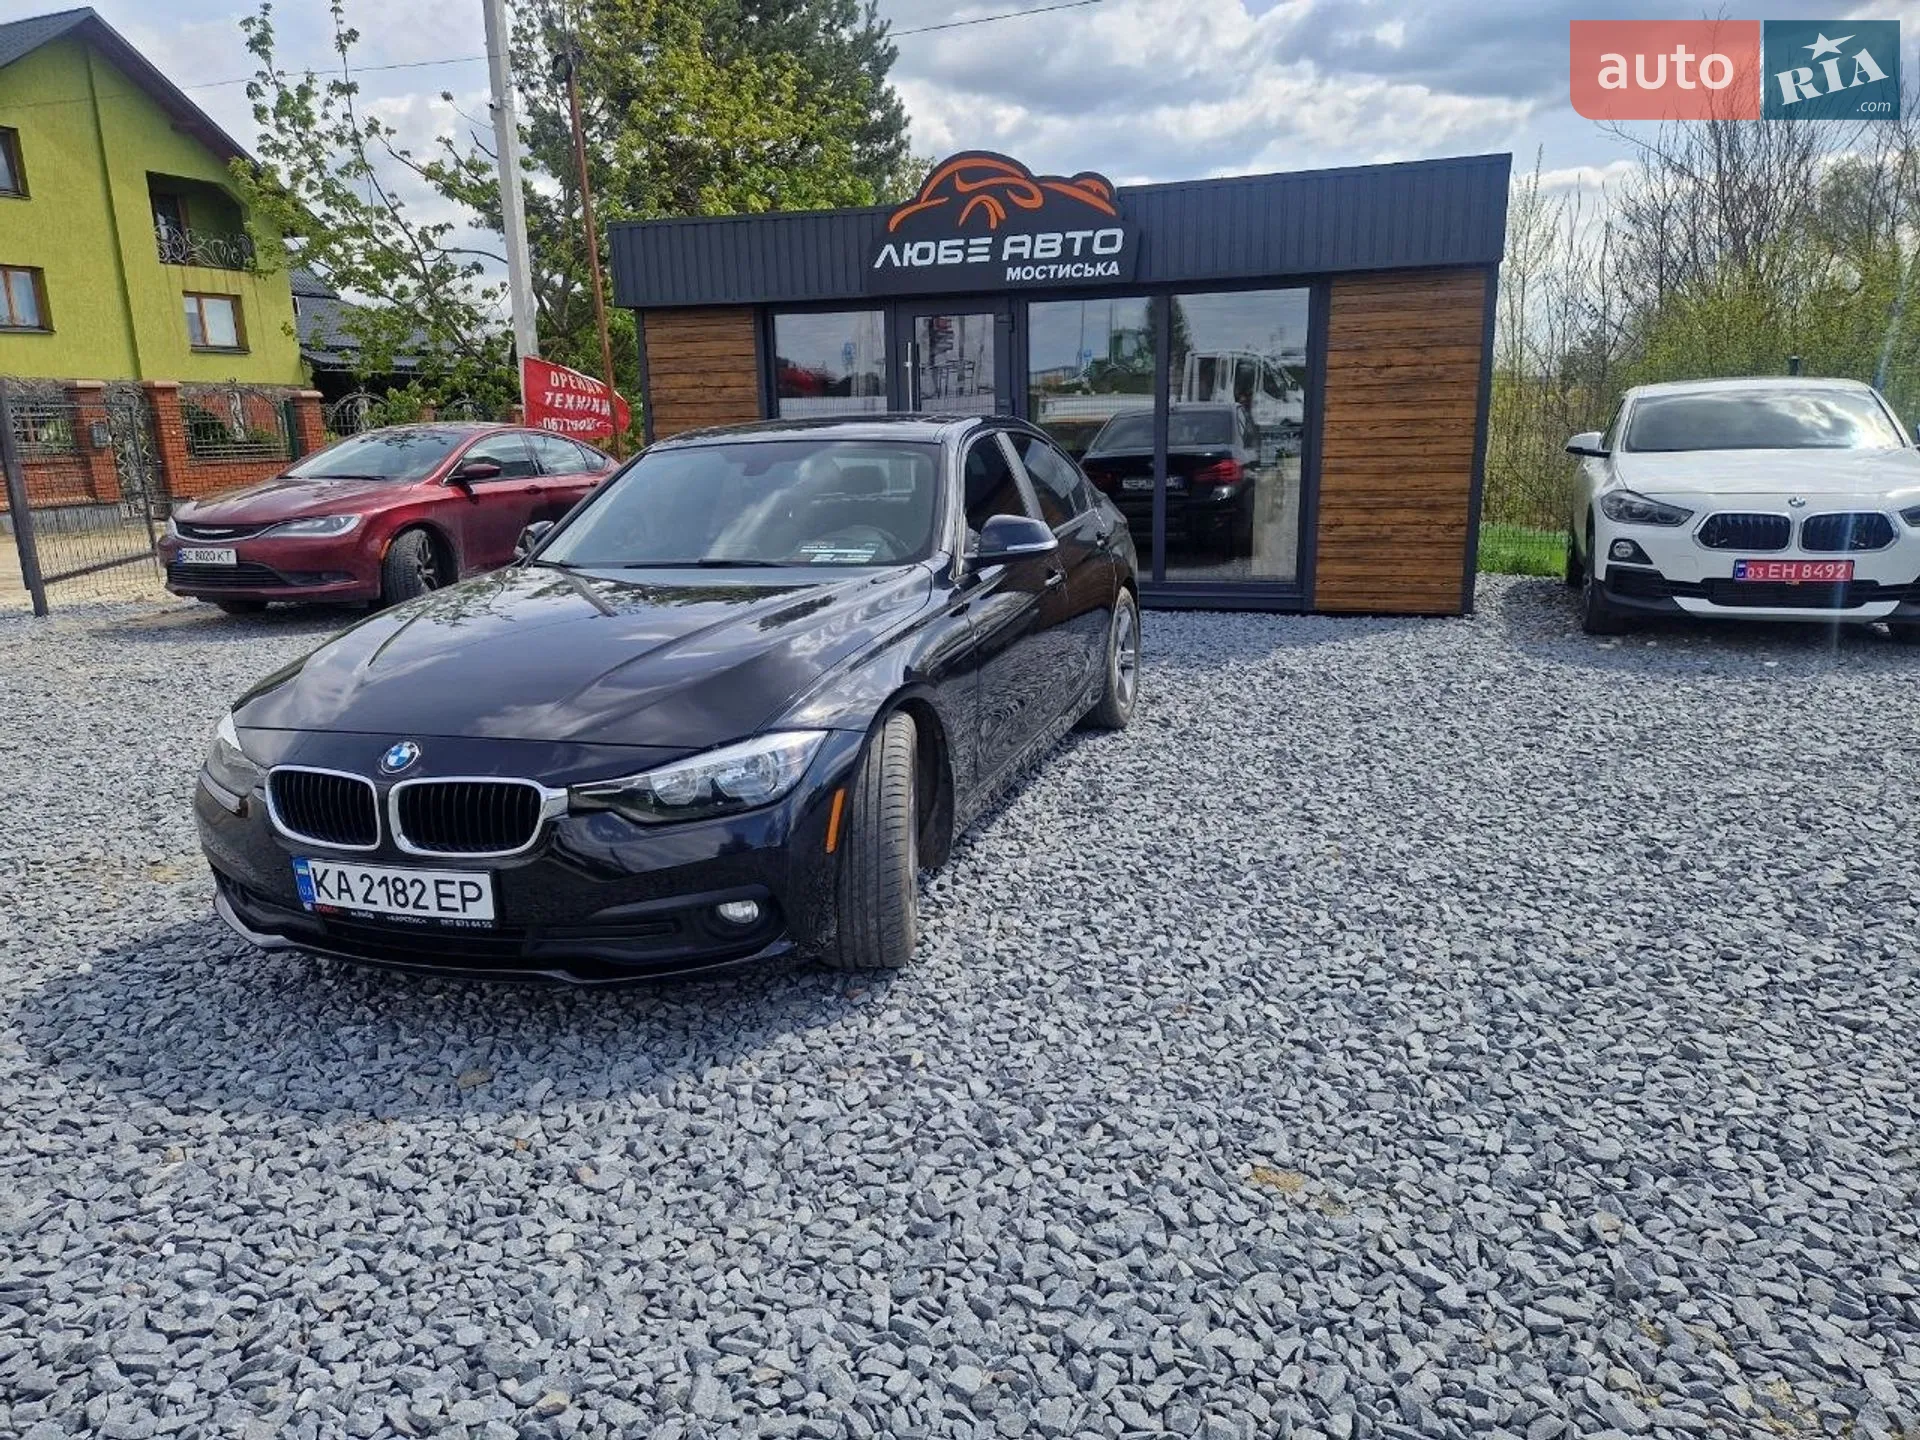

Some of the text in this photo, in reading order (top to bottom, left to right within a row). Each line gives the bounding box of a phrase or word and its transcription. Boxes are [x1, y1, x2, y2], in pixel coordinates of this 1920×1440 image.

[874, 227, 1124, 268] ЛЮБЕ АВТО
[1005, 261, 1120, 282] МОСТИСЬКА
[550, 370, 604, 394] ОРЕНДА
[1747, 566, 1764, 579] 03
[1768, 564, 1796, 579] EH
[1801, 564, 1847, 579] 8492
[311, 867, 483, 913] KA 2182 EP
